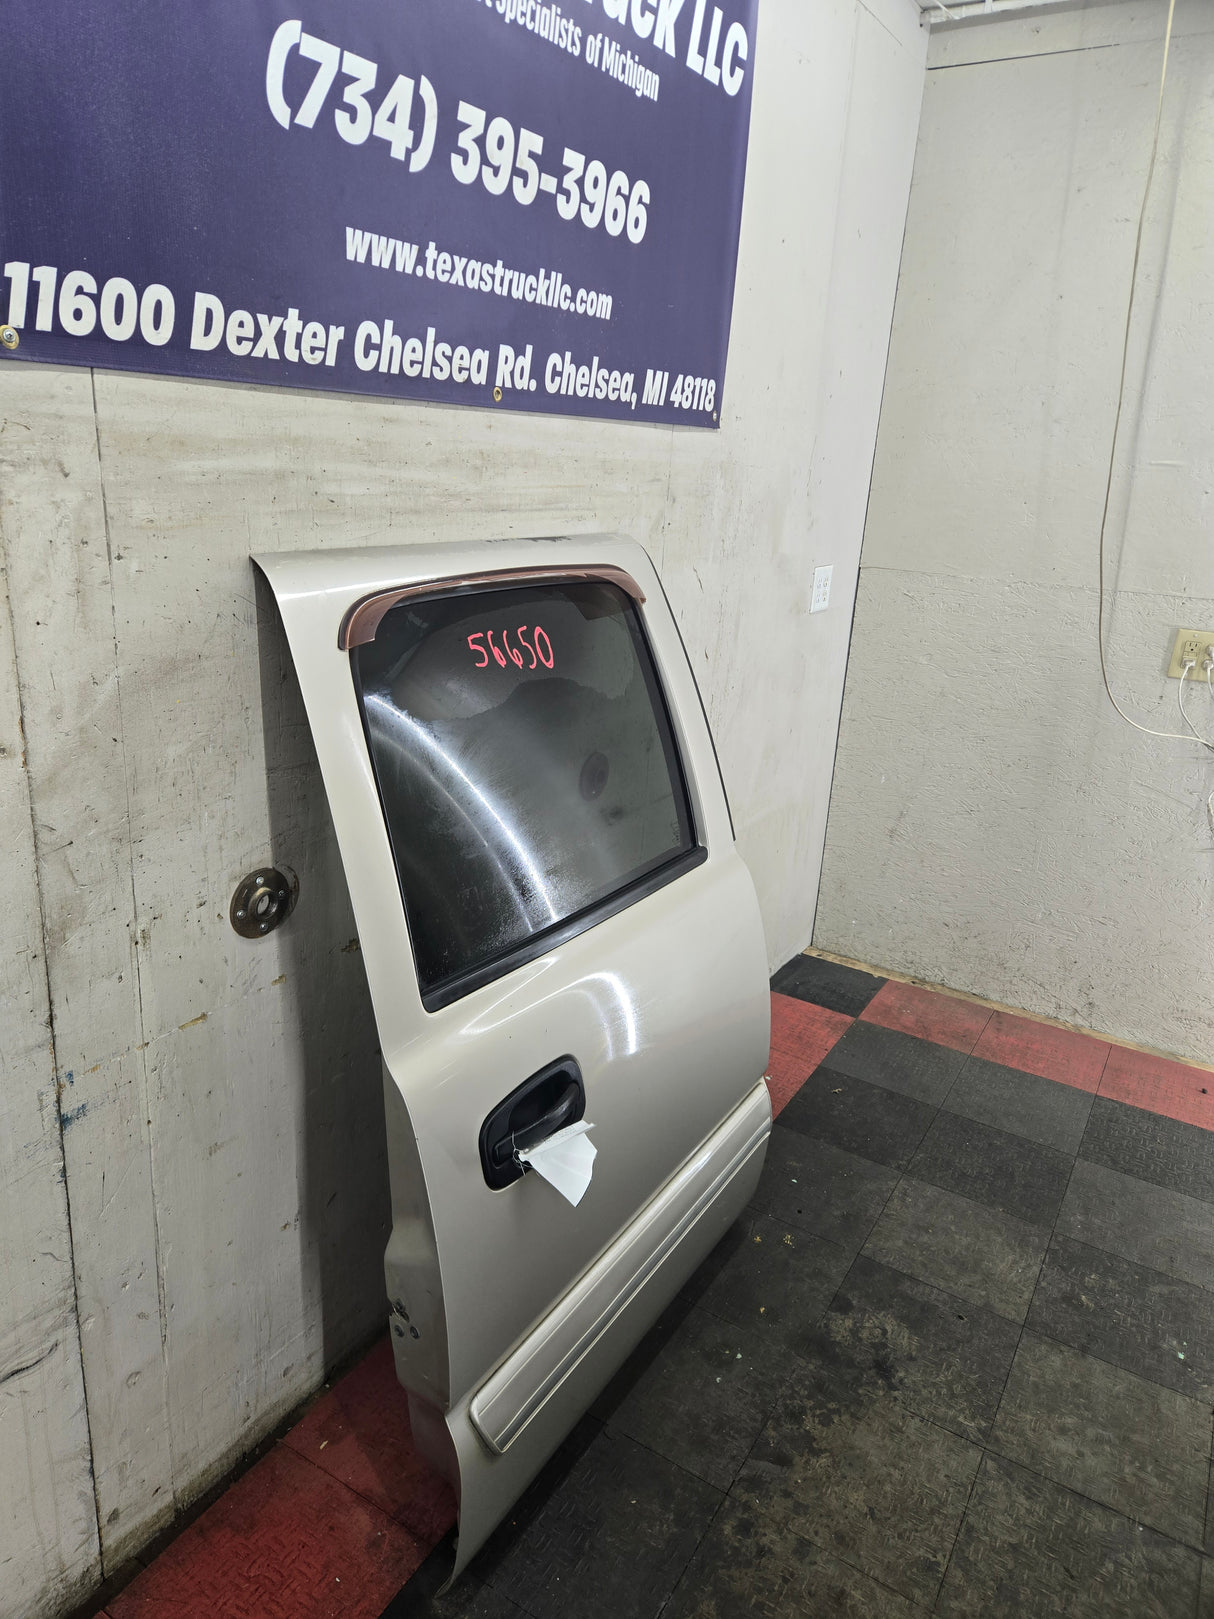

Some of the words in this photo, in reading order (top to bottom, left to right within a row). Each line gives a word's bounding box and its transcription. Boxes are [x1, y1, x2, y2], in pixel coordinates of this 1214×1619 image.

[585, 33, 603, 68] of
[601, 36, 660, 102] Michigan
[686, 0, 748, 97] LLC
[266, 19, 438, 173] (734)
[451, 100, 651, 244] 395-3966
[345, 226, 613, 320] www.texastruckllc.com
[4, 261, 176, 346] 11600
[190, 291, 345, 367] Dexter
[354, 318, 489, 385] Chelsea
[495, 343, 537, 392] Rd.
[545, 351, 638, 410] Chelsea,
[642, 368, 670, 410] MI
[669, 374, 716, 412] 48118
[467, 625, 554, 669] 56650
